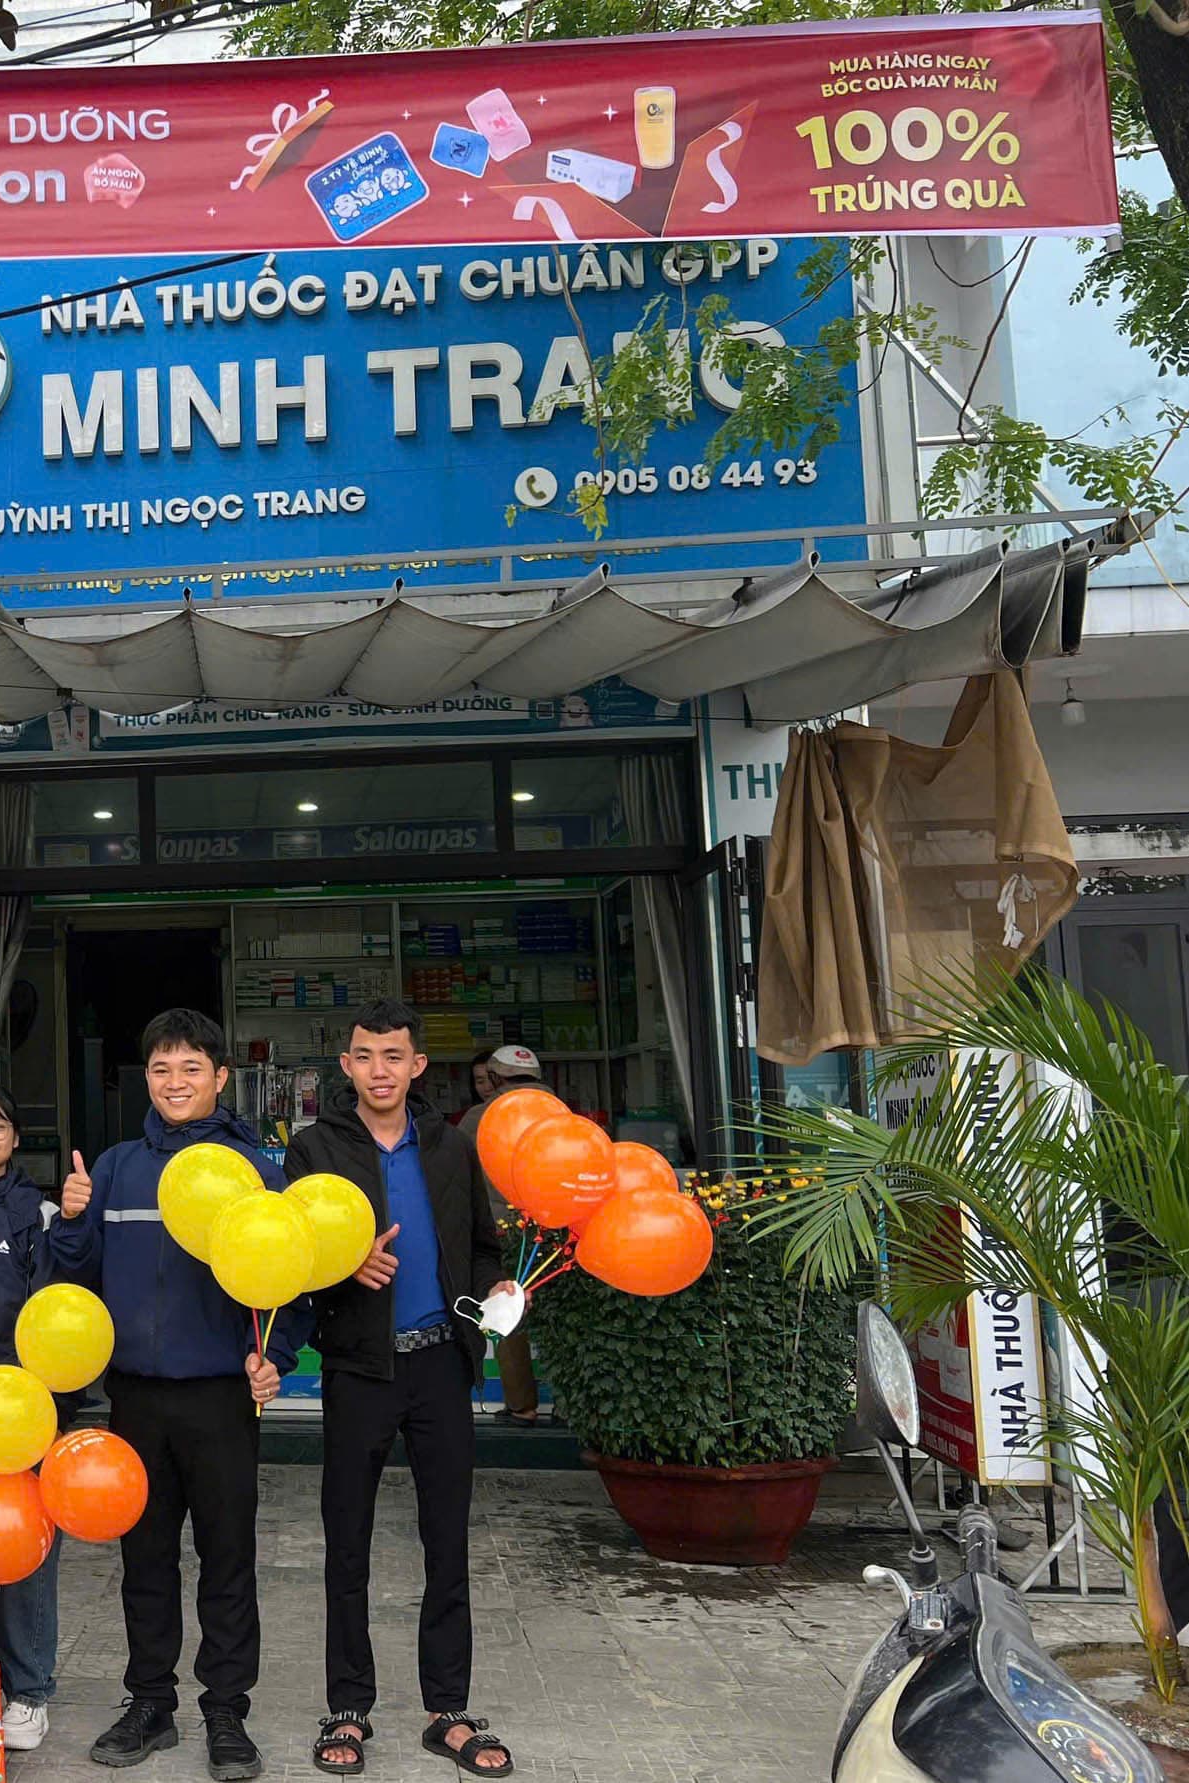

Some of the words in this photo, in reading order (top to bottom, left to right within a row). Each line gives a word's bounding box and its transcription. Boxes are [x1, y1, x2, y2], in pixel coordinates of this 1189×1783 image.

[829, 57, 873, 75] MUA
[876, 51, 933, 70] HÀNG
[936, 54, 991, 71] NGAY
[820, 76, 862, 97] BỐC
[865, 73, 908, 90] QUÀ
[911, 75, 950, 88] MAY
[954, 71, 997, 94] MẮN
[9, 106, 170, 143] DƯỠNG
[795, 106, 1020, 170] 100%
[108, 168, 138, 179] NGON
[809, 174, 938, 213] TRÚNG
[944, 174, 1026, 211] QUÀ
[41, 275, 144, 335] NHÀ
[156, 252, 327, 326] THUỐC
[343, 264, 442, 315] ĐẠT
[662, 238, 778, 286] GPP
[42, 355, 327, 459] MINH
[574, 467, 660, 497] 0905
[668, 463, 711, 492] 08
[720, 460, 765, 488] 44
[773, 458, 818, 485] 93
[82, 501, 132, 534] THỊ
[141, 494, 244, 529] NGỌC
[253, 486, 366, 519] TRANG
[353, 825, 477, 854] Salonpas
[982, 1281, 1024, 1372] THUỐ
[991, 1381, 1030, 1448] NHÀ
